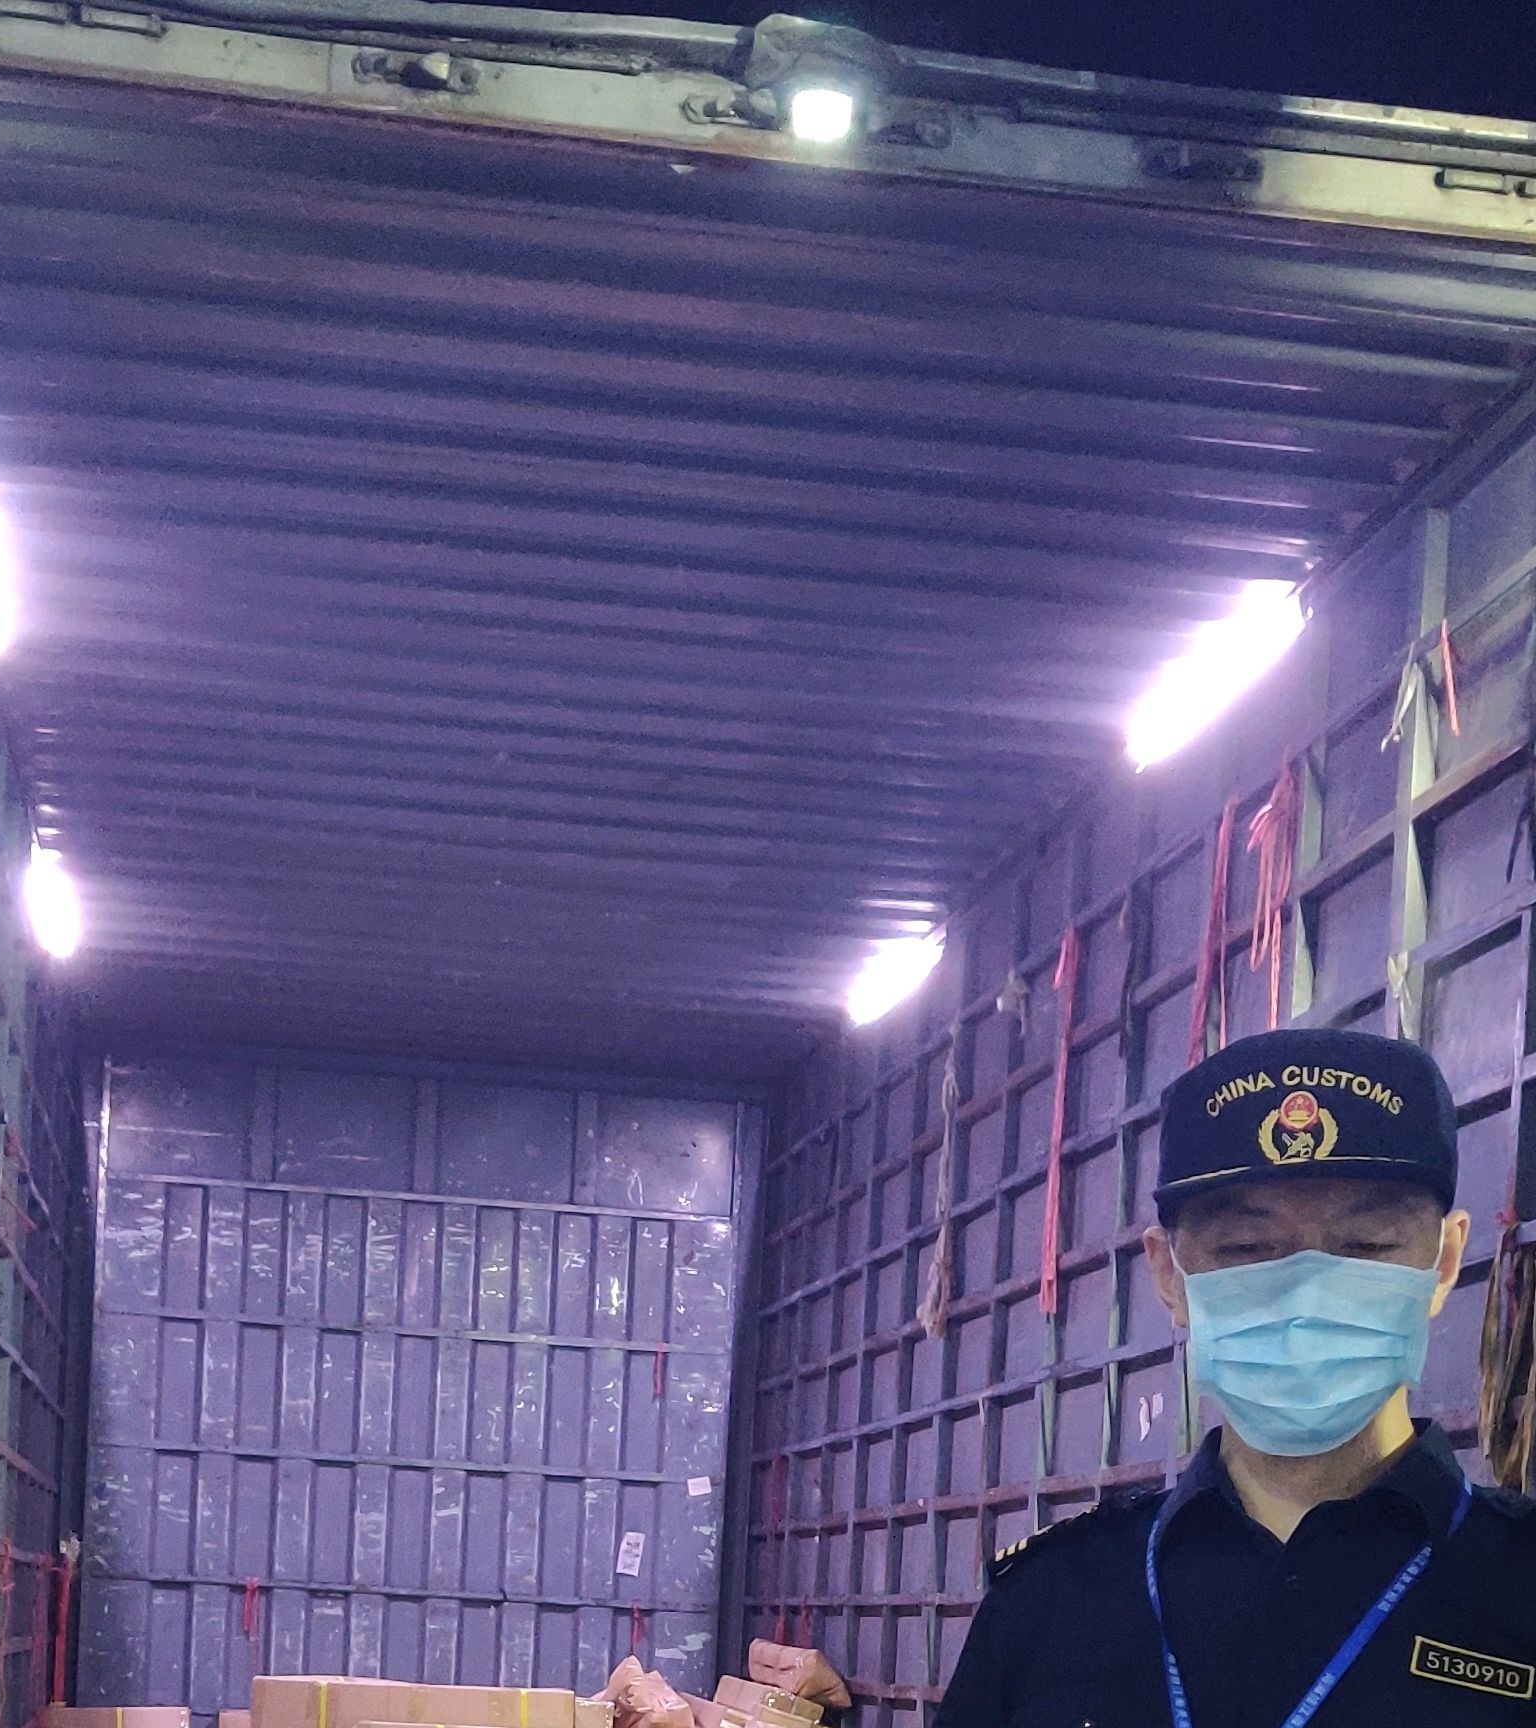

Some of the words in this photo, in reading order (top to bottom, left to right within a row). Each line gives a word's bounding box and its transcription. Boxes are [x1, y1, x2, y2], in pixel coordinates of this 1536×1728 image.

[1206, 1071, 1275, 1117] CHINA
[1282, 1065, 1404, 1116] CUSTOMS
[1426, 1651, 1520, 1687] 5130910
